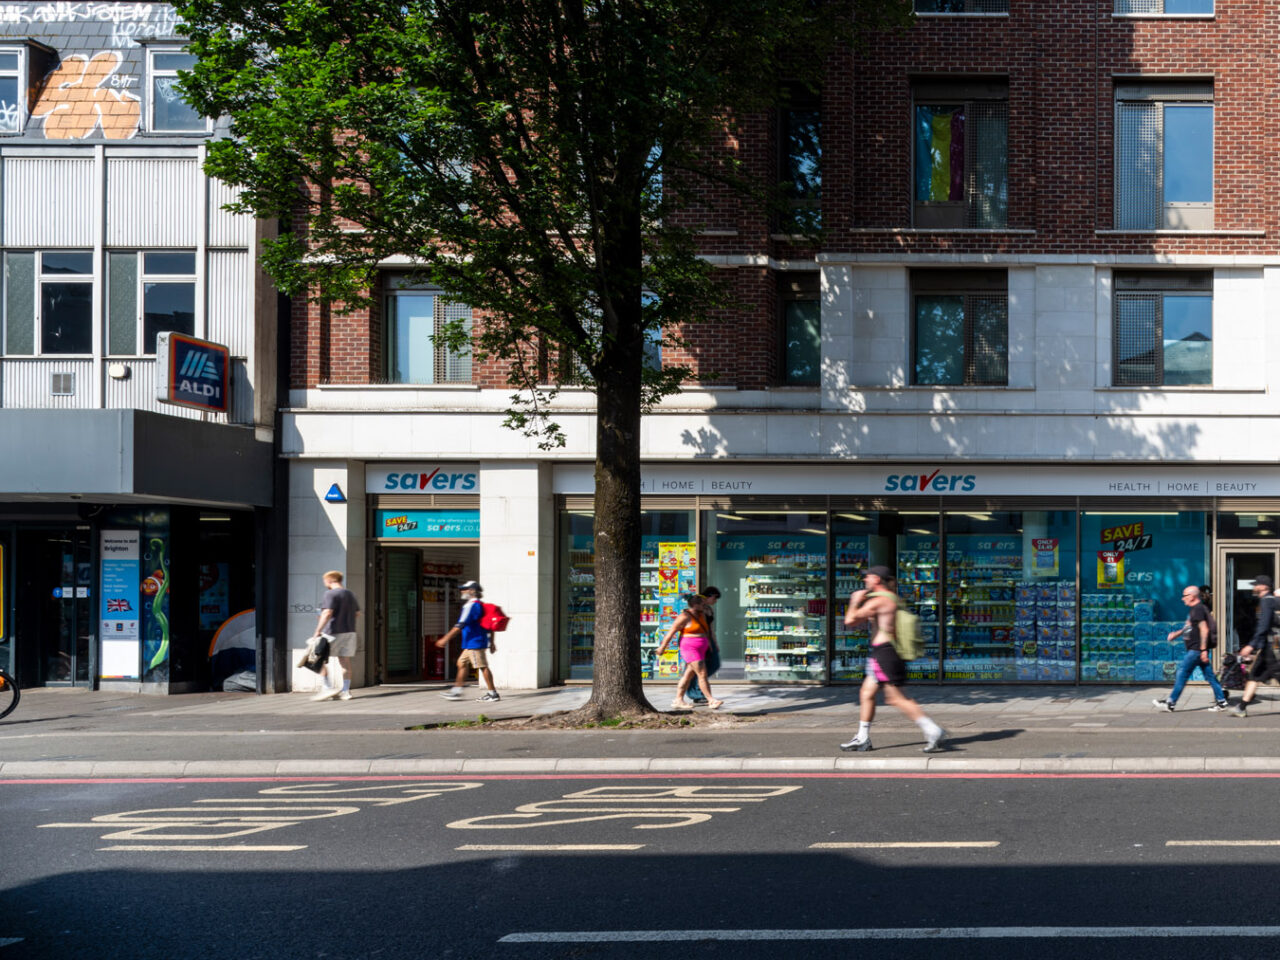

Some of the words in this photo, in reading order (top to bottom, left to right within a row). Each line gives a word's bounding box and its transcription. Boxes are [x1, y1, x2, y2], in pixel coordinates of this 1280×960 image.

[180, 379, 220, 398] ALDI
[384, 467, 476, 490] savers
[884, 468, 976, 492] savers
[662, 480, 695, 490] HOME
[711, 480, 753, 490] BEAUTY
[1108, 482, 1151, 491] HEALTH
[1167, 482, 1199, 491] HOME
[1216, 482, 1257, 491] BEAUTY
[385, 516, 408, 526] SAVE
[398, 522, 417, 531] 24/7
[427, 522, 480, 532] savers.co.u
[1103, 523, 1142, 541] SAVE
[767, 539, 806, 550] savers
[835, 539, 866, 550] avers
[977, 539, 1016, 550] savers
[1117, 535, 1151, 552] 24/7
